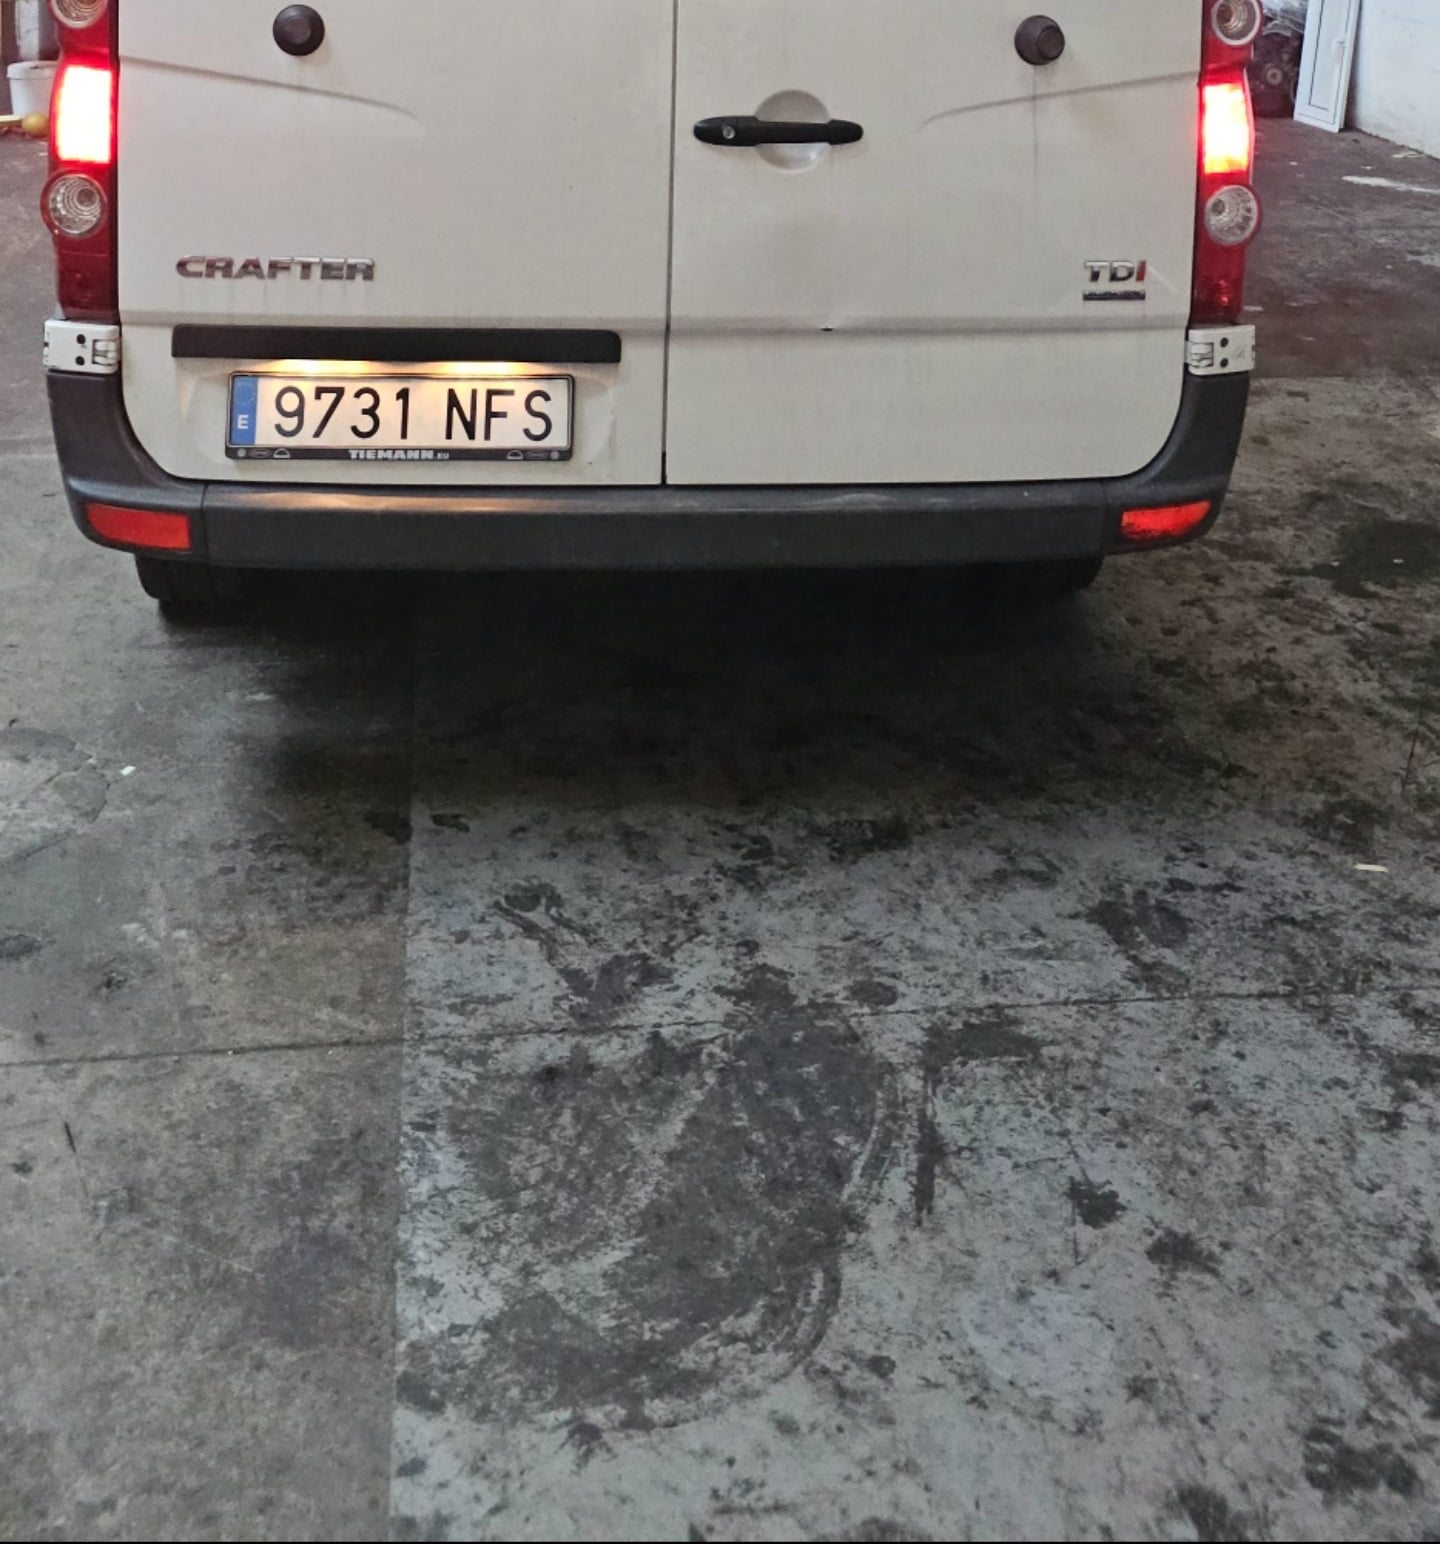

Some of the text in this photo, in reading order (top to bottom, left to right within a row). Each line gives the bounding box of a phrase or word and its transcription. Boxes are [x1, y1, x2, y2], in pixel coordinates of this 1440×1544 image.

[175, 255, 376, 281] CRAFTER
[1083, 259, 1147, 283] TDI
[237, 385, 553, 442] E 9731 NFS
